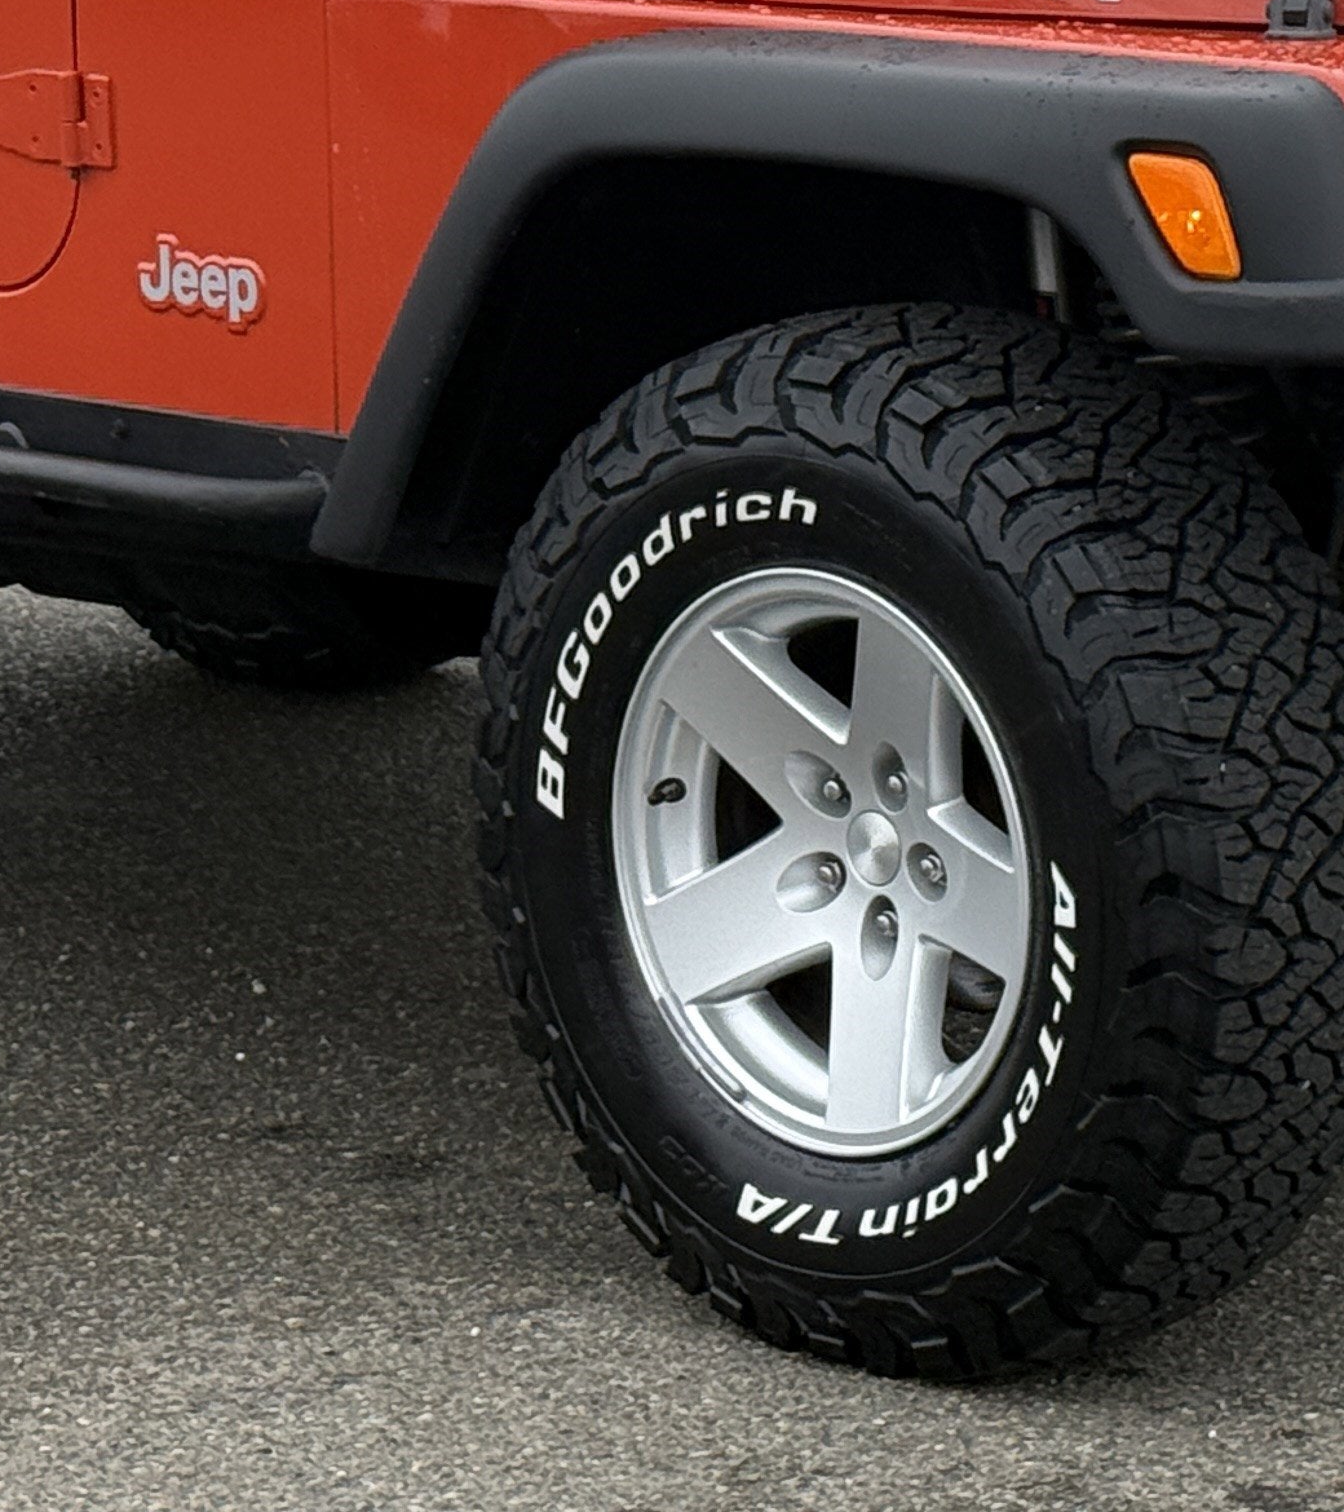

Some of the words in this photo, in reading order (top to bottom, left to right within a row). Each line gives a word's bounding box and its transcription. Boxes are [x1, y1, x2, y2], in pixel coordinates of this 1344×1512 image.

[137, 234, 264, 333] Jeep
[534, 484, 820, 821] BFGoodrich
[857, 860, 1082, 1240] All-Terrain
[735, 1180, 845, 1247] T/A
